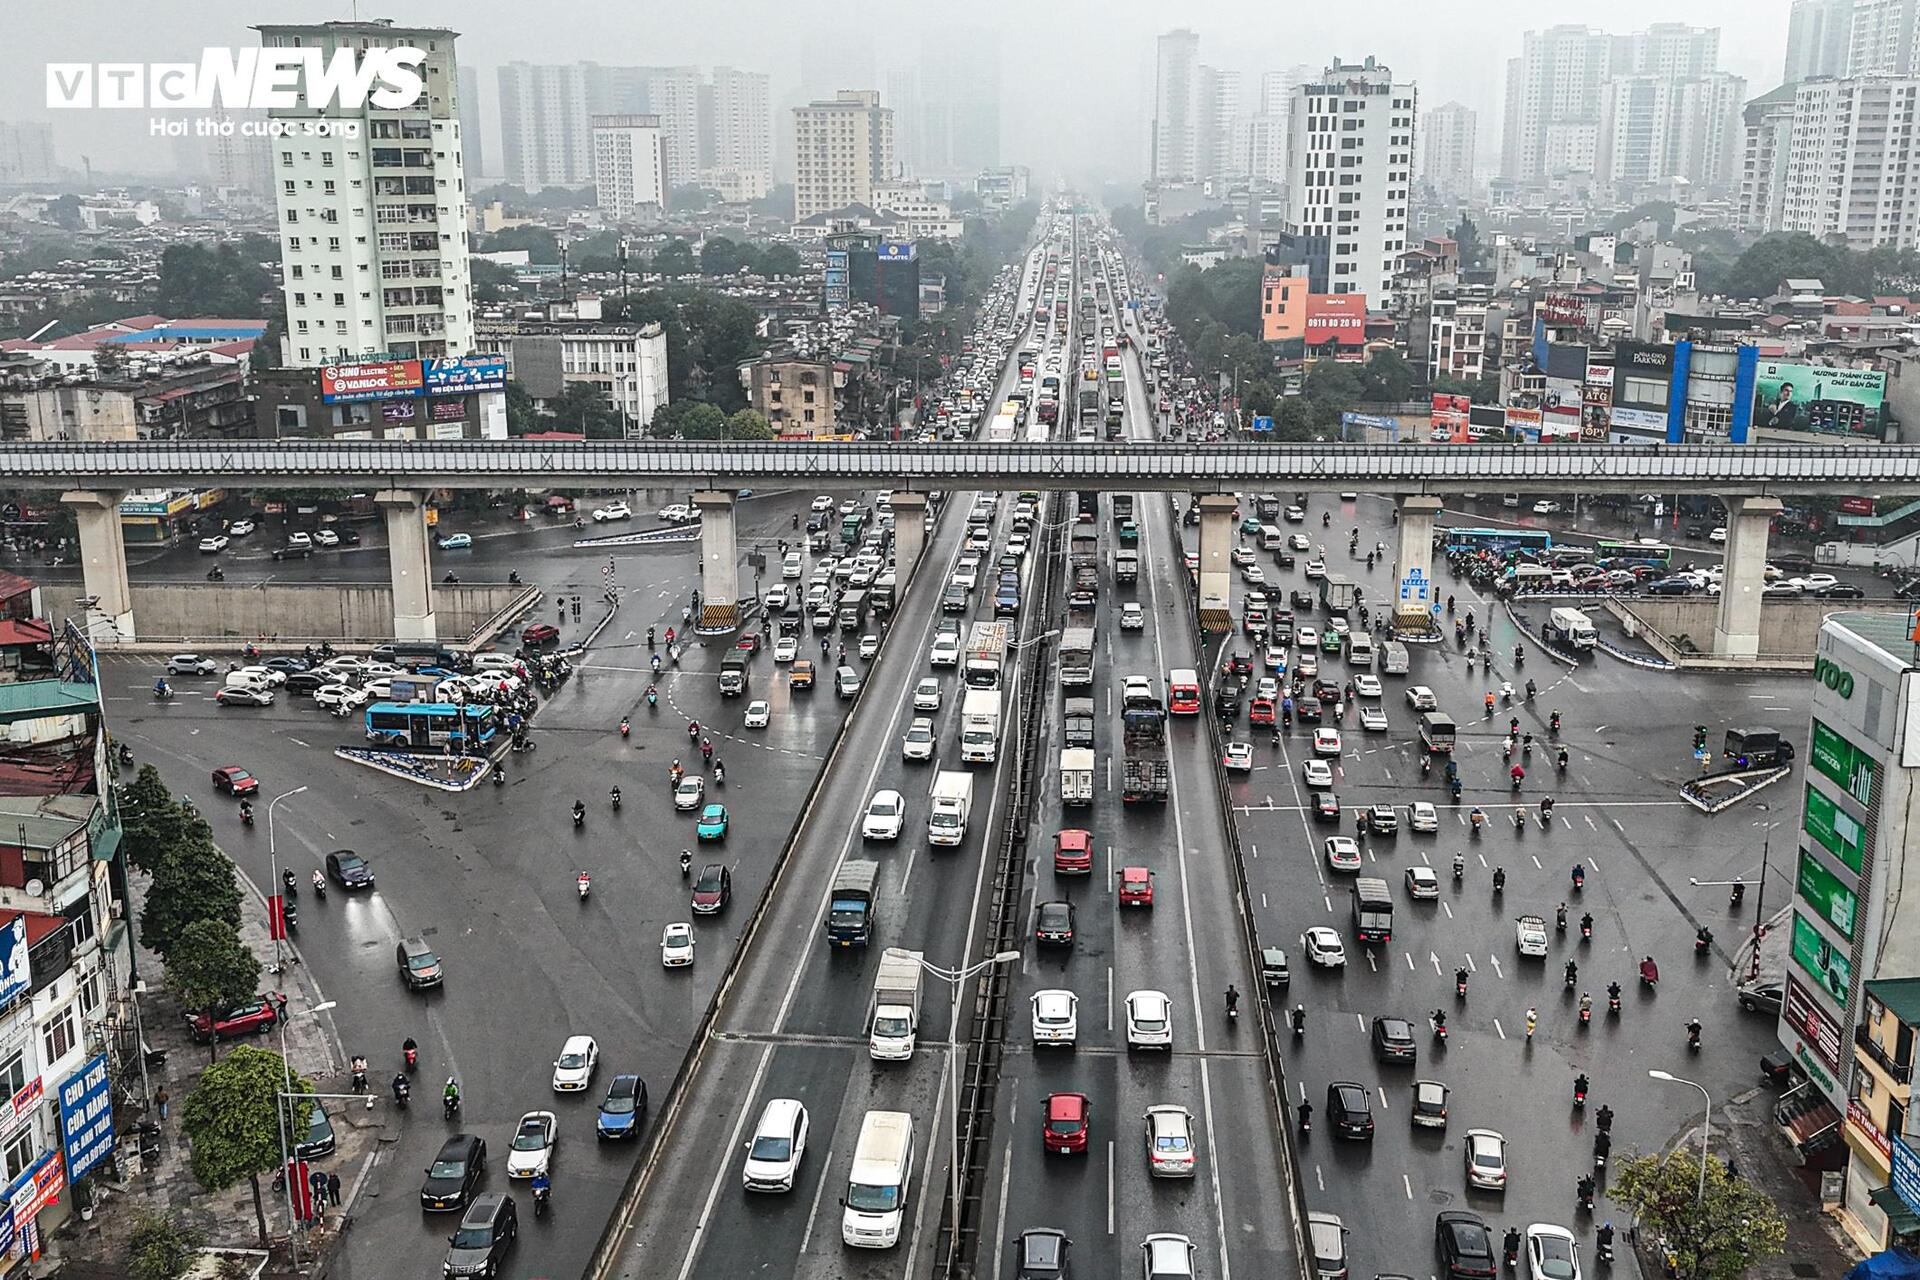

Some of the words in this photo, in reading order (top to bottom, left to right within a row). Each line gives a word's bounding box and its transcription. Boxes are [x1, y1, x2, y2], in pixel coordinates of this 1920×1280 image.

[442, 358, 459, 369] SP
[1633, 353, 1667, 365] PARKWAY
[339, 367, 360, 378] SINO
[360, 368, 388, 376] ELECTRIC
[1812, 369, 1838, 378] HƯƠNG
[1863, 373, 1882, 381] CÔNG
[346, 378, 389, 389] VANLOCK
[1585, 391, 1608, 400] ATG
[64, 1079, 84, 1107] CHO
[85, 1059, 106, 1092] THUÊ
[67, 1107, 86, 1136] CỬA
[86, 1089, 109, 1121] HÀNG
[80, 1127, 94, 1149] ANH
